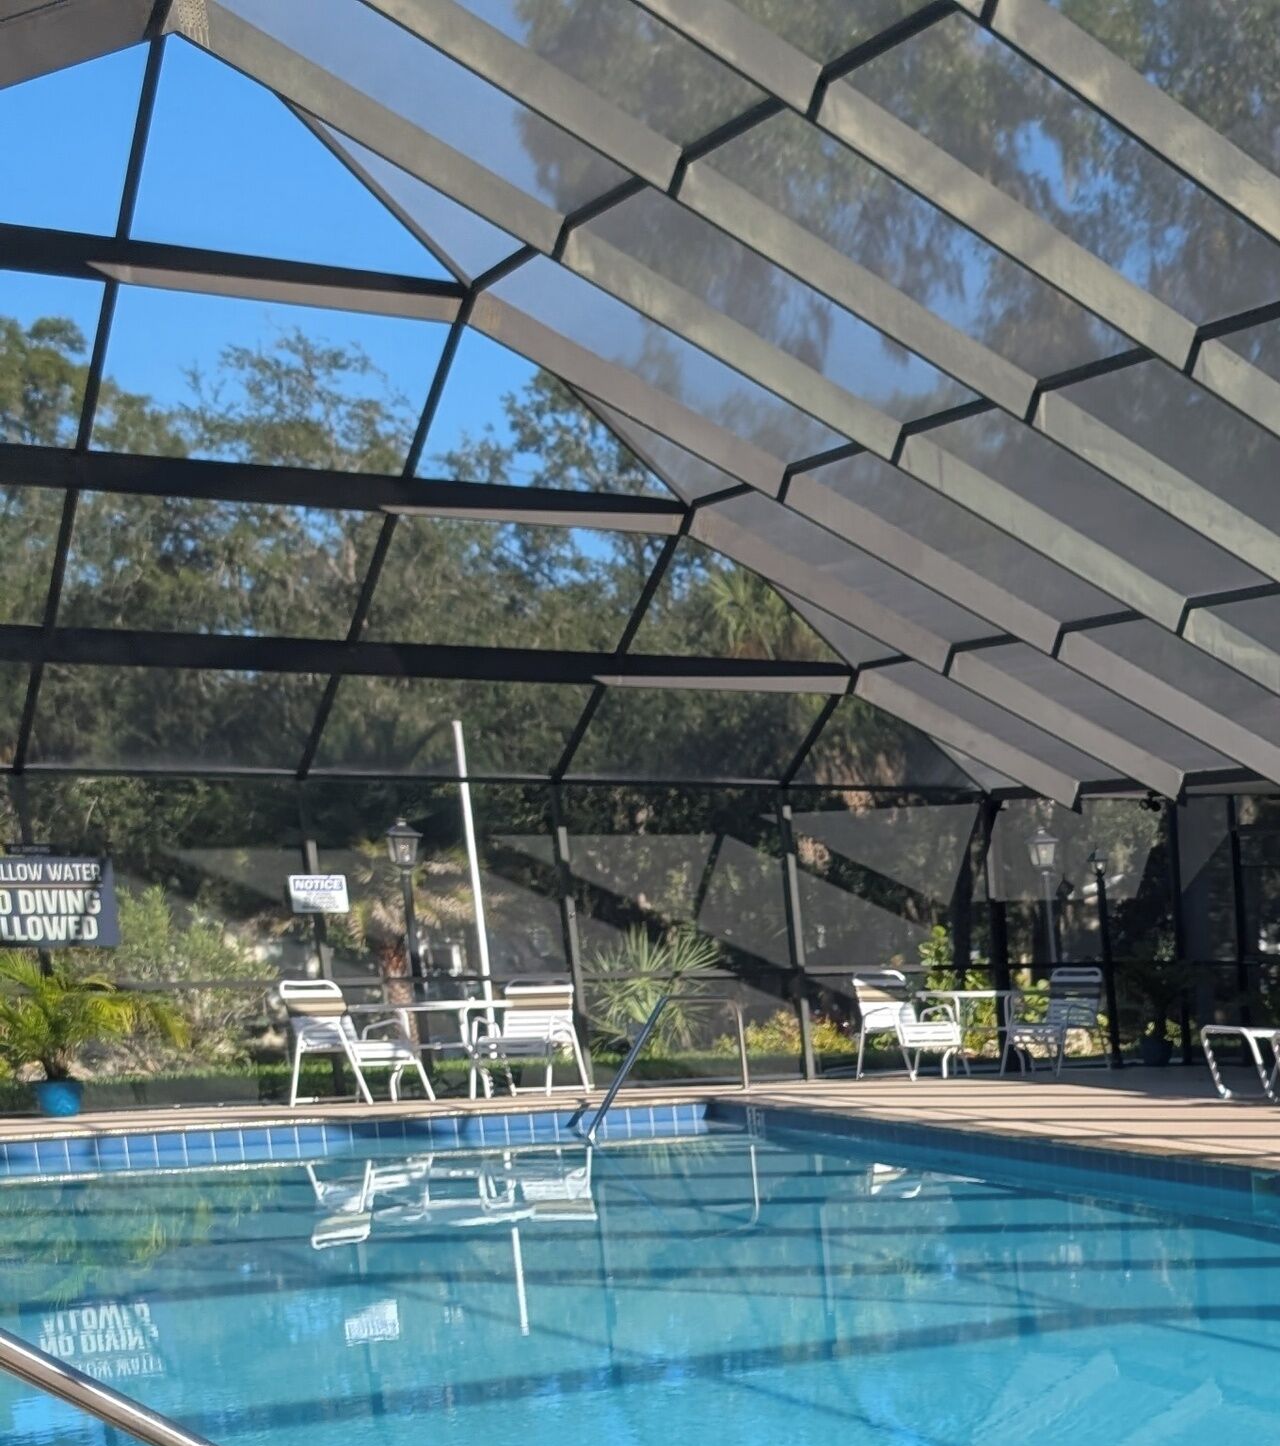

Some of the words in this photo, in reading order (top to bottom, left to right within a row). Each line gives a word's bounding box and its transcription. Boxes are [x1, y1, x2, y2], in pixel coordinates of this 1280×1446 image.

[0, 863, 43, 881] LLOW
[47, 862, 102, 881] WATER
[294, 880, 343, 890] NOTICE
[0, 889, 13, 915] O
[18, 889, 102, 915] DIVING
[0, 915, 99, 941] LLOWED
